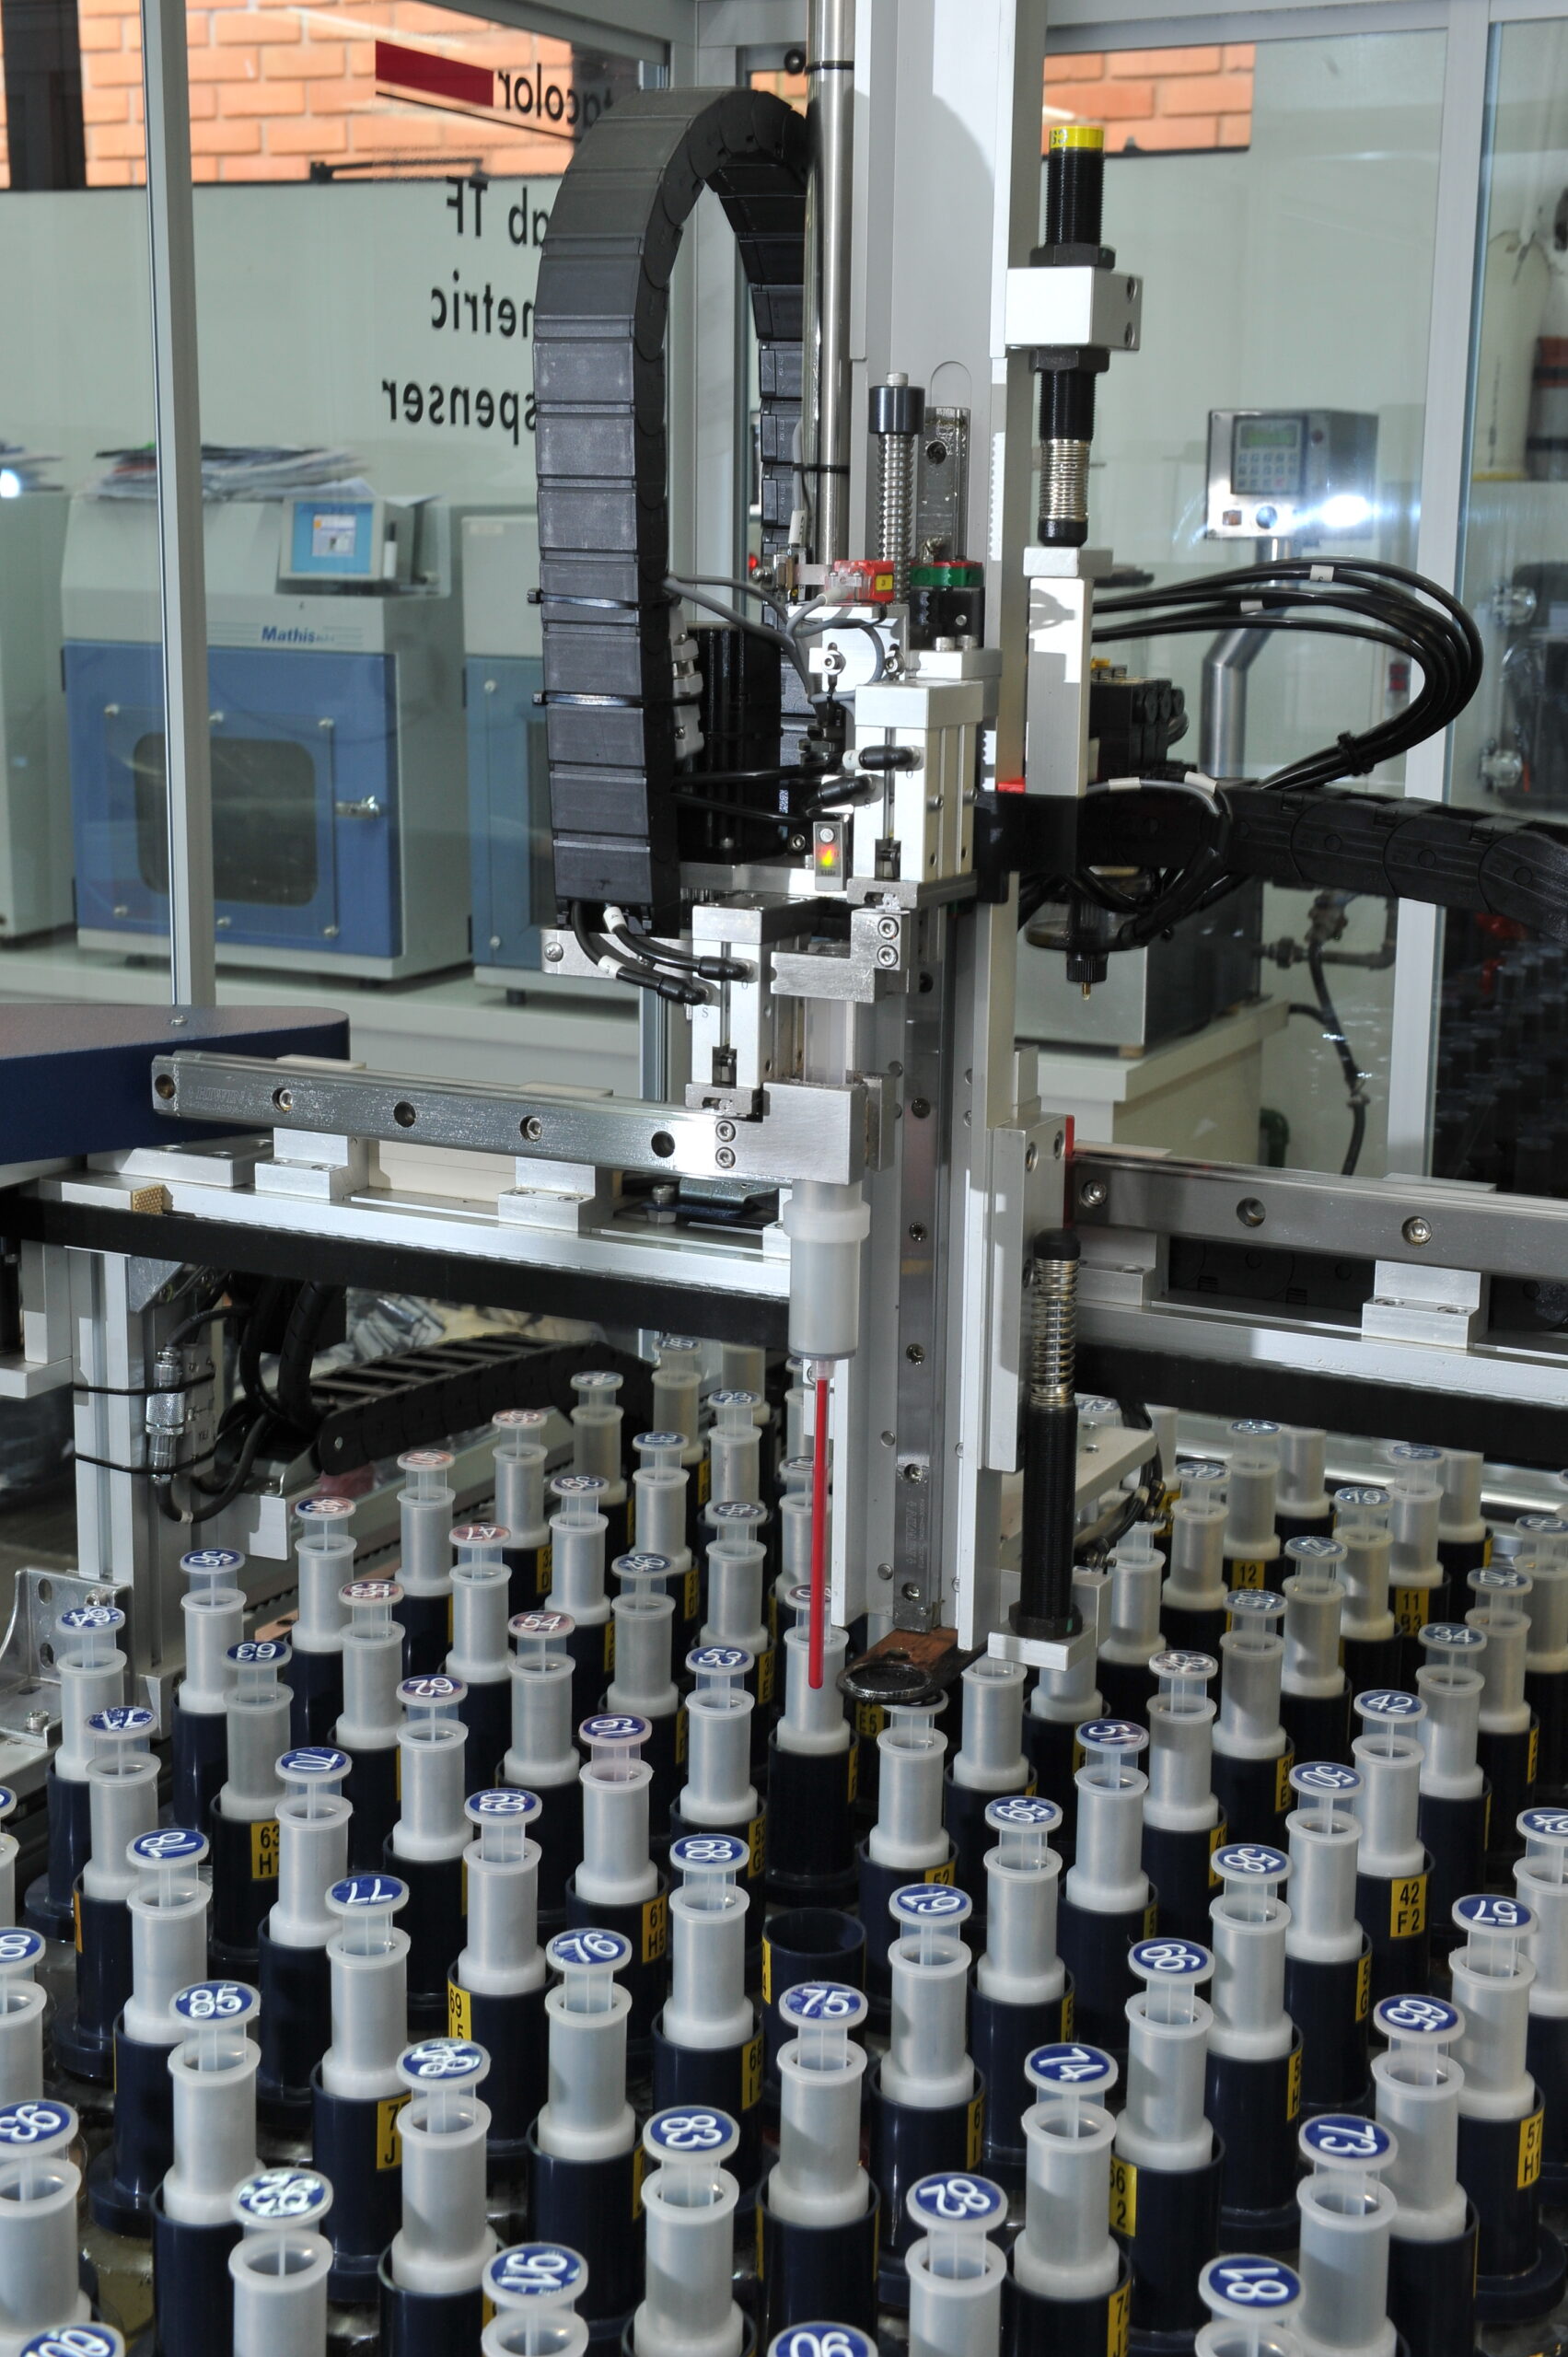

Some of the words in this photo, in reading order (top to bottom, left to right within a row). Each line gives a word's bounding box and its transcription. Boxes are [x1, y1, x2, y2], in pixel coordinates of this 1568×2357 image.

[261, 625, 315, 644] Mathis
[465, 1526, 497, 1540] 47
[189, 1550, 235, 1567] 56
[627, 1554, 667, 1572] 46
[1240, 1565, 1257, 1582] 12
[351, 1583, 390, 1598] 55
[1402, 1594, 1419, 1610] 11
[70, 1606, 112, 1628] 64
[520, 1613, 562, 1631] 54
[1434, 1625, 1474, 1644] 34
[237, 1643, 277, 1662] 63
[698, 1648, 743, 1668] 53
[409, 1676, 454, 1698] 62
[1366, 1692, 1414, 1713] 42
[589, 1716, 639, 1738] 61
[1087, 1724, 1144, 1745] 51
[287, 1752, 341, 1771] 70
[1301, 1765, 1355, 1788] 50
[479, 1793, 527, 1812] 69
[996, 1798, 1052, 1823] 59
[140, 1831, 198, 1858] 78
[684, 1840, 734, 1861] 68
[1223, 1847, 1282, 1874] 58
[345, 1878, 394, 1905] 77
[900, 1890, 961, 1914] 67
[1400, 1881, 1421, 1905] 42
[649, 1904, 664, 1926] 61
[1398, 1909, 1421, 1934] F2
[1471, 1899, 1519, 1925] 57
[556, 1933, 620, 1963] 76
[648, 1935, 665, 1958] H5
[188, 1986, 244, 2019] 85
[450, 1988, 462, 2018] 69
[799, 1988, 852, 2017] 75
[1385, 1998, 1450, 2032] 65
[411, 2043, 475, 2077] 84
[1038, 2047, 1105, 2082] 74
[660, 2114, 724, 2151] 83
[1318, 2124, 1379, 2157] 73
[1527, 2121, 1542, 2149] 57
[1525, 2154, 1541, 2185] H1
[919, 2177, 993, 2218] 82
[497, 2252, 568, 2287] 91
[1218, 2267, 1290, 2301] 81
